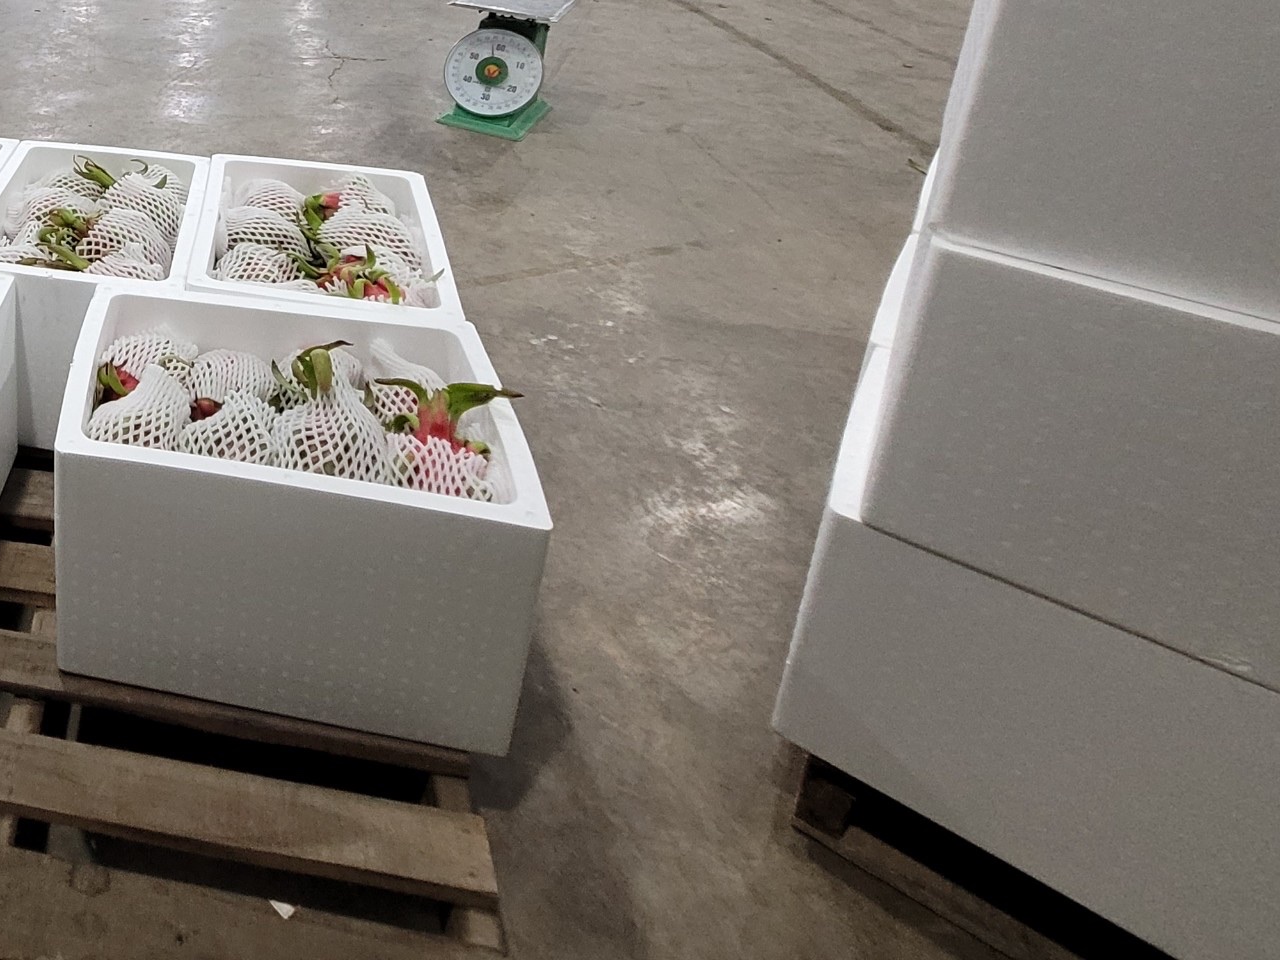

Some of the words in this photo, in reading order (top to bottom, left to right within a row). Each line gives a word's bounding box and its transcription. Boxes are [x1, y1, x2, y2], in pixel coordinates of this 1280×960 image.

[469, 52, 479, 60] 50
[463, 75, 472, 83] 40
[507, 85, 517, 93] 20
[480, 93, 491, 101] 30
